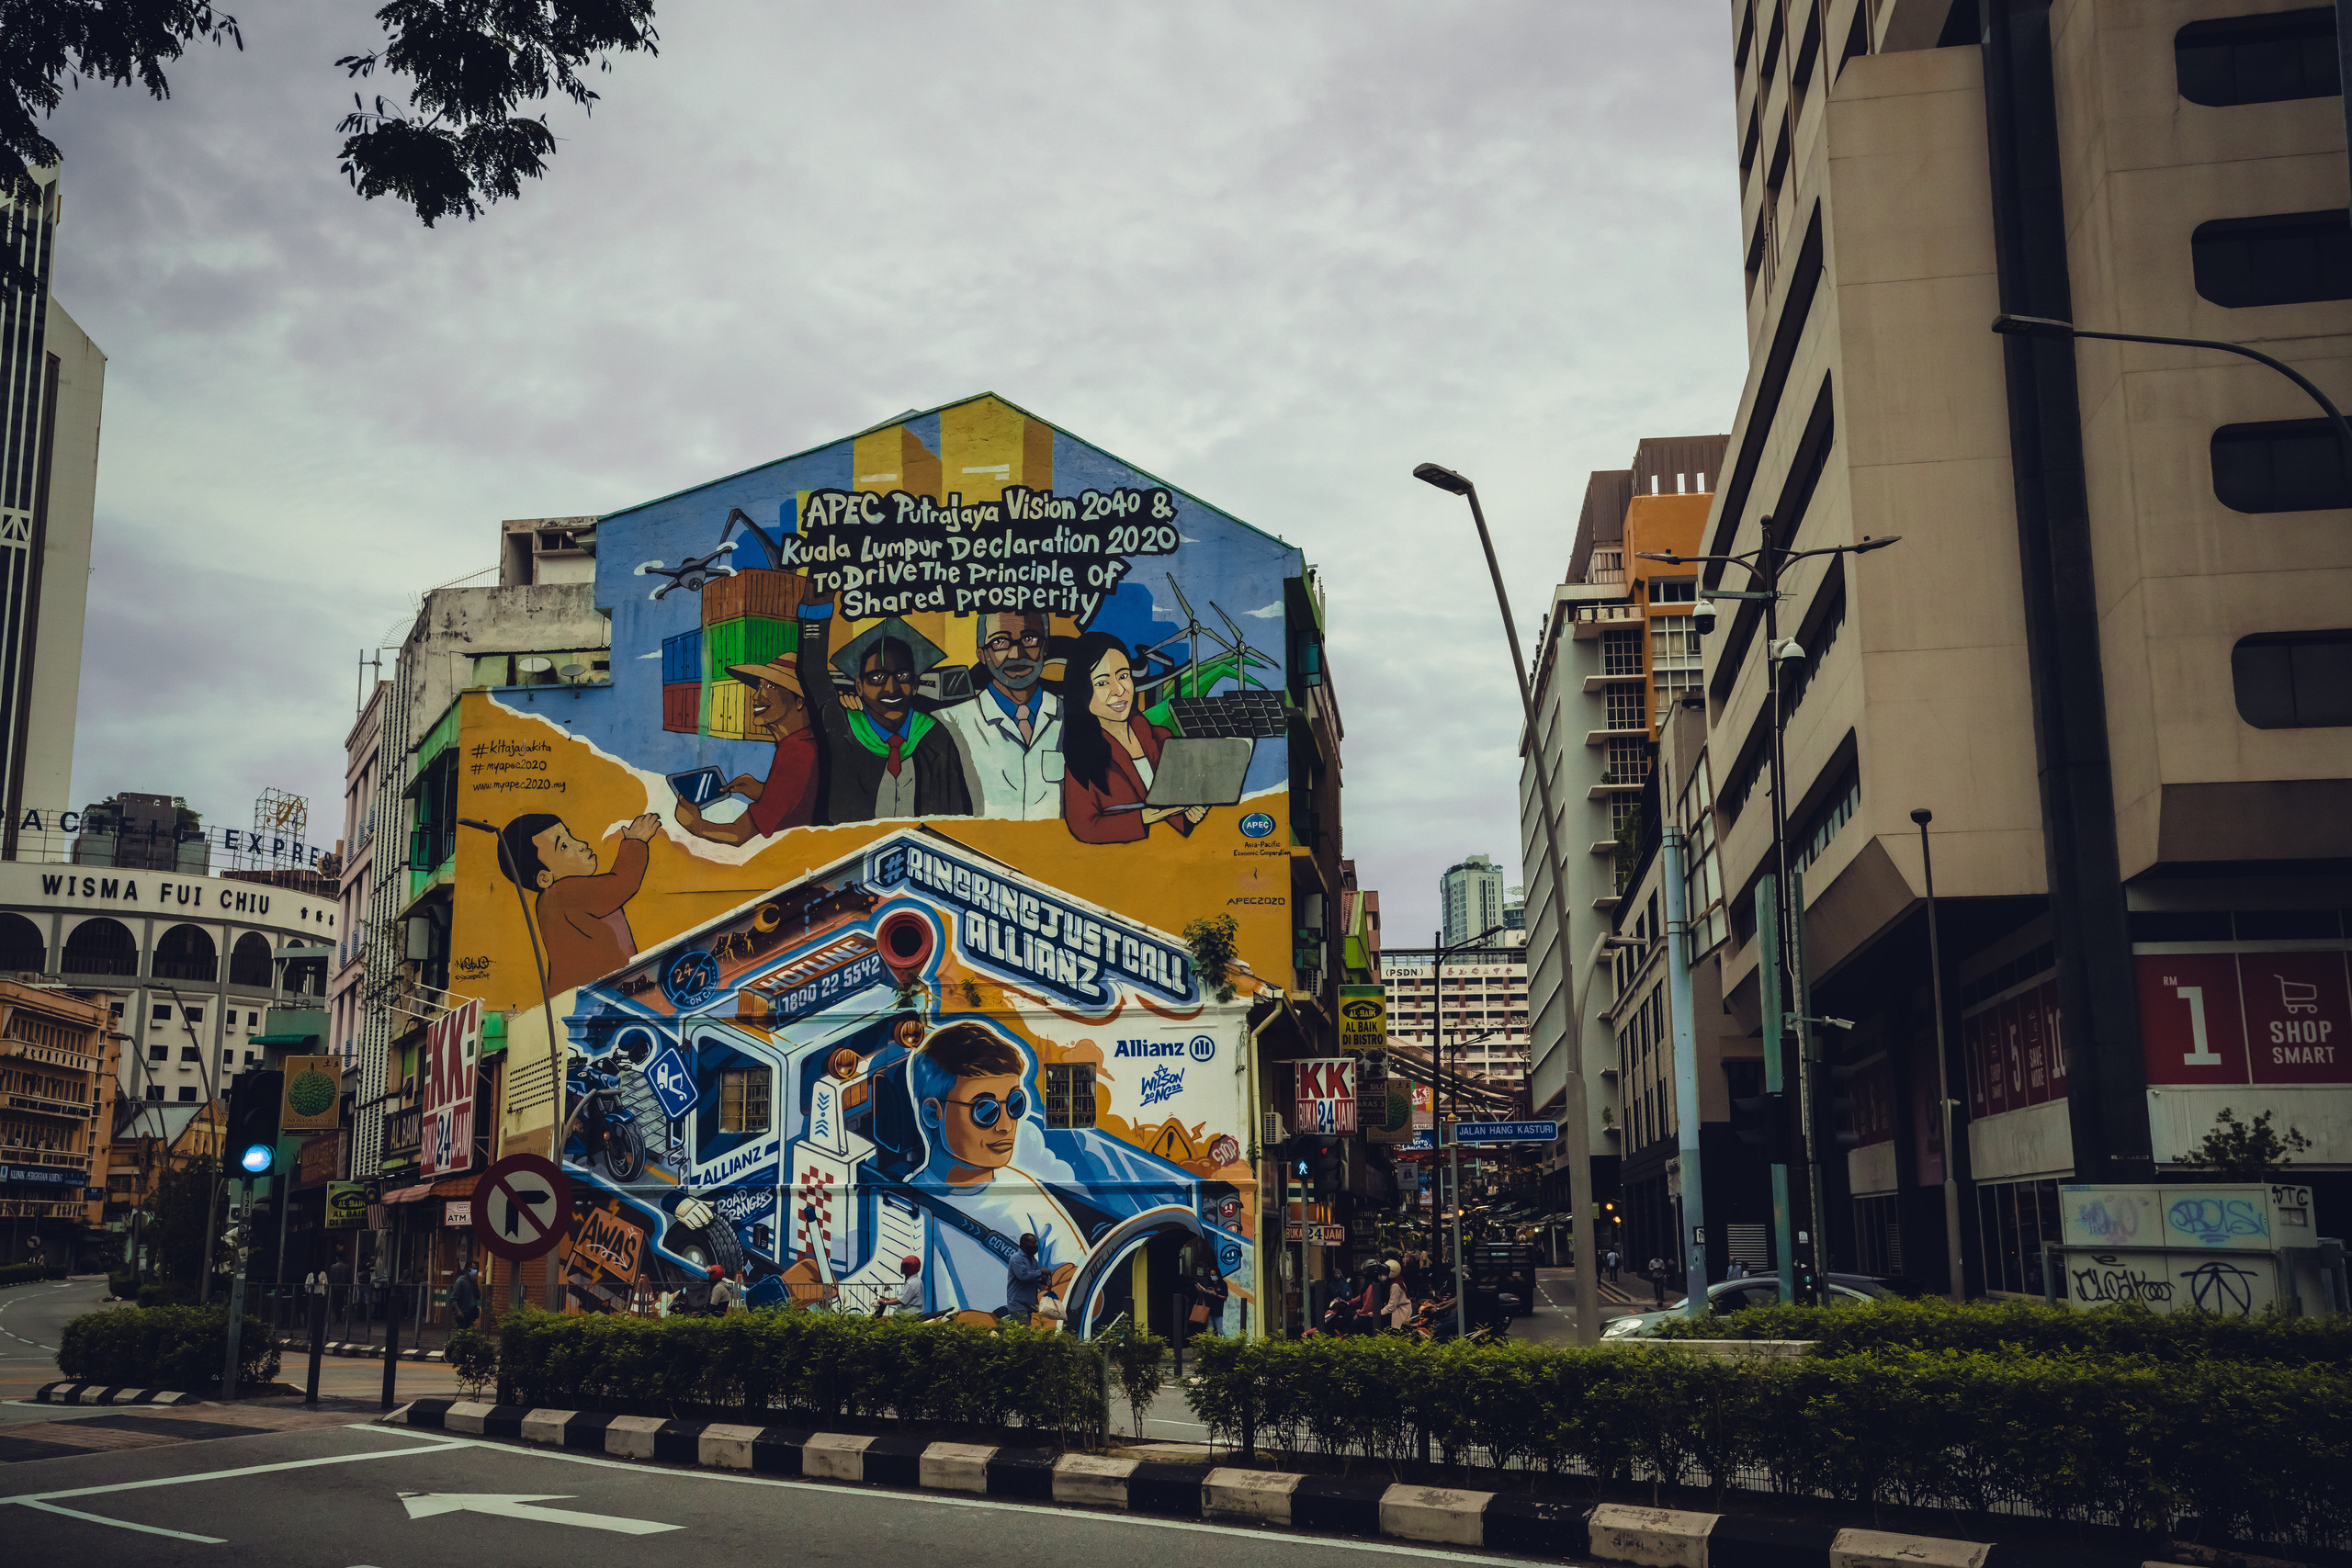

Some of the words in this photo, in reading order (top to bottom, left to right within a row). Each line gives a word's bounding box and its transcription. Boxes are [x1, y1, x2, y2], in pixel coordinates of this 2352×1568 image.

[807, 492, 886, 527] APEC
[892, 492, 1000, 532] Putrajaya
[1004, 489, 1076, 522] Vision
[1081, 491, 1141, 518] 2040
[1150, 491, 1174, 517] &
[781, 535, 851, 566] Kuala
[860, 535, 943, 563] Lumpur
[946, 525, 1100, 558] Declaration
[1105, 525, 1177, 555] 2020
[919, 561, 960, 584] The
[967, 558, 1073, 588] Principle
[1088, 562, 1124, 590] of
[844, 584, 944, 615] Shared
[471, 738, 552, 759] #kitajagakita
[473, 778, 566, 793] www.myapec2020.my
[1246, 821, 1269, 829] APEC
[1233, 849, 1259, 857] Economic
[1260, 849, 1291, 858] Cooperation
[1244, 840, 1281, 849] Asia-Pacific
[42, 874, 138, 901] WISMA
[160, 883, 201, 907] FUI
[220, 889, 270, 915] CHIU
[1227, 897, 1285, 906] APEC2020
[759, 940, 869, 991] HOTLINE
[964, 910, 1101, 998] ALLIANZ
[781, 986, 817, 1012] 1800
[821, 973, 840, 998] 22
[843, 954, 881, 987] 5542
[2163, 976, 2178, 987] RM
[1342, 1034, 1351, 1045] DI
[1353, 1034, 1384, 1045] BISTRO
[1345, 1021, 1356, 1032] AL
[1358, 1021, 1378, 1032] BAIK
[2177, 987, 2222, 1066] 1
[2269, 1020, 2333, 1043] SHOP
[430, 1003, 469, 1111] KK
[1114, 1039, 1185, 1058] Allianz
[2029, 1045, 2043, 1068] SAVE
[2272, 1046, 2335, 1065] SMART
[1299, 1062, 1351, 1100] KK
[1298, 1101, 1317, 1134] BUKA
[1317, 1100, 1335, 1134] 24
[1336, 1101, 1354, 1131] JAM
[1459, 1126, 1486, 1135] JALAN
[1489, 1125, 1513, 1134] HANG
[1518, 1124, 1554, 1134] KASTURI
[390, 1119, 401, 1150] AL
[401, 1112, 422, 1147] BAIK
[421, 1122, 436, 1167] BUKA
[436, 1111, 451, 1168] 24
[451, 1111, 470, 1159] JAM
[1212, 1139, 1238, 1166] STOP
[697, 1145, 763, 1189] ALLIANZ
[346, 1210, 367, 1218] BAIK
[717, 1190, 748, 1213] ROAD
[725, 1188, 775, 1224] RANGERS
[578, 1213, 638, 1272] AWAS
[1285, 1227, 1303, 1239] BUKA
[1308, 1227, 1323, 1240] 24
[1325, 1228, 1342, 1240] JAM
